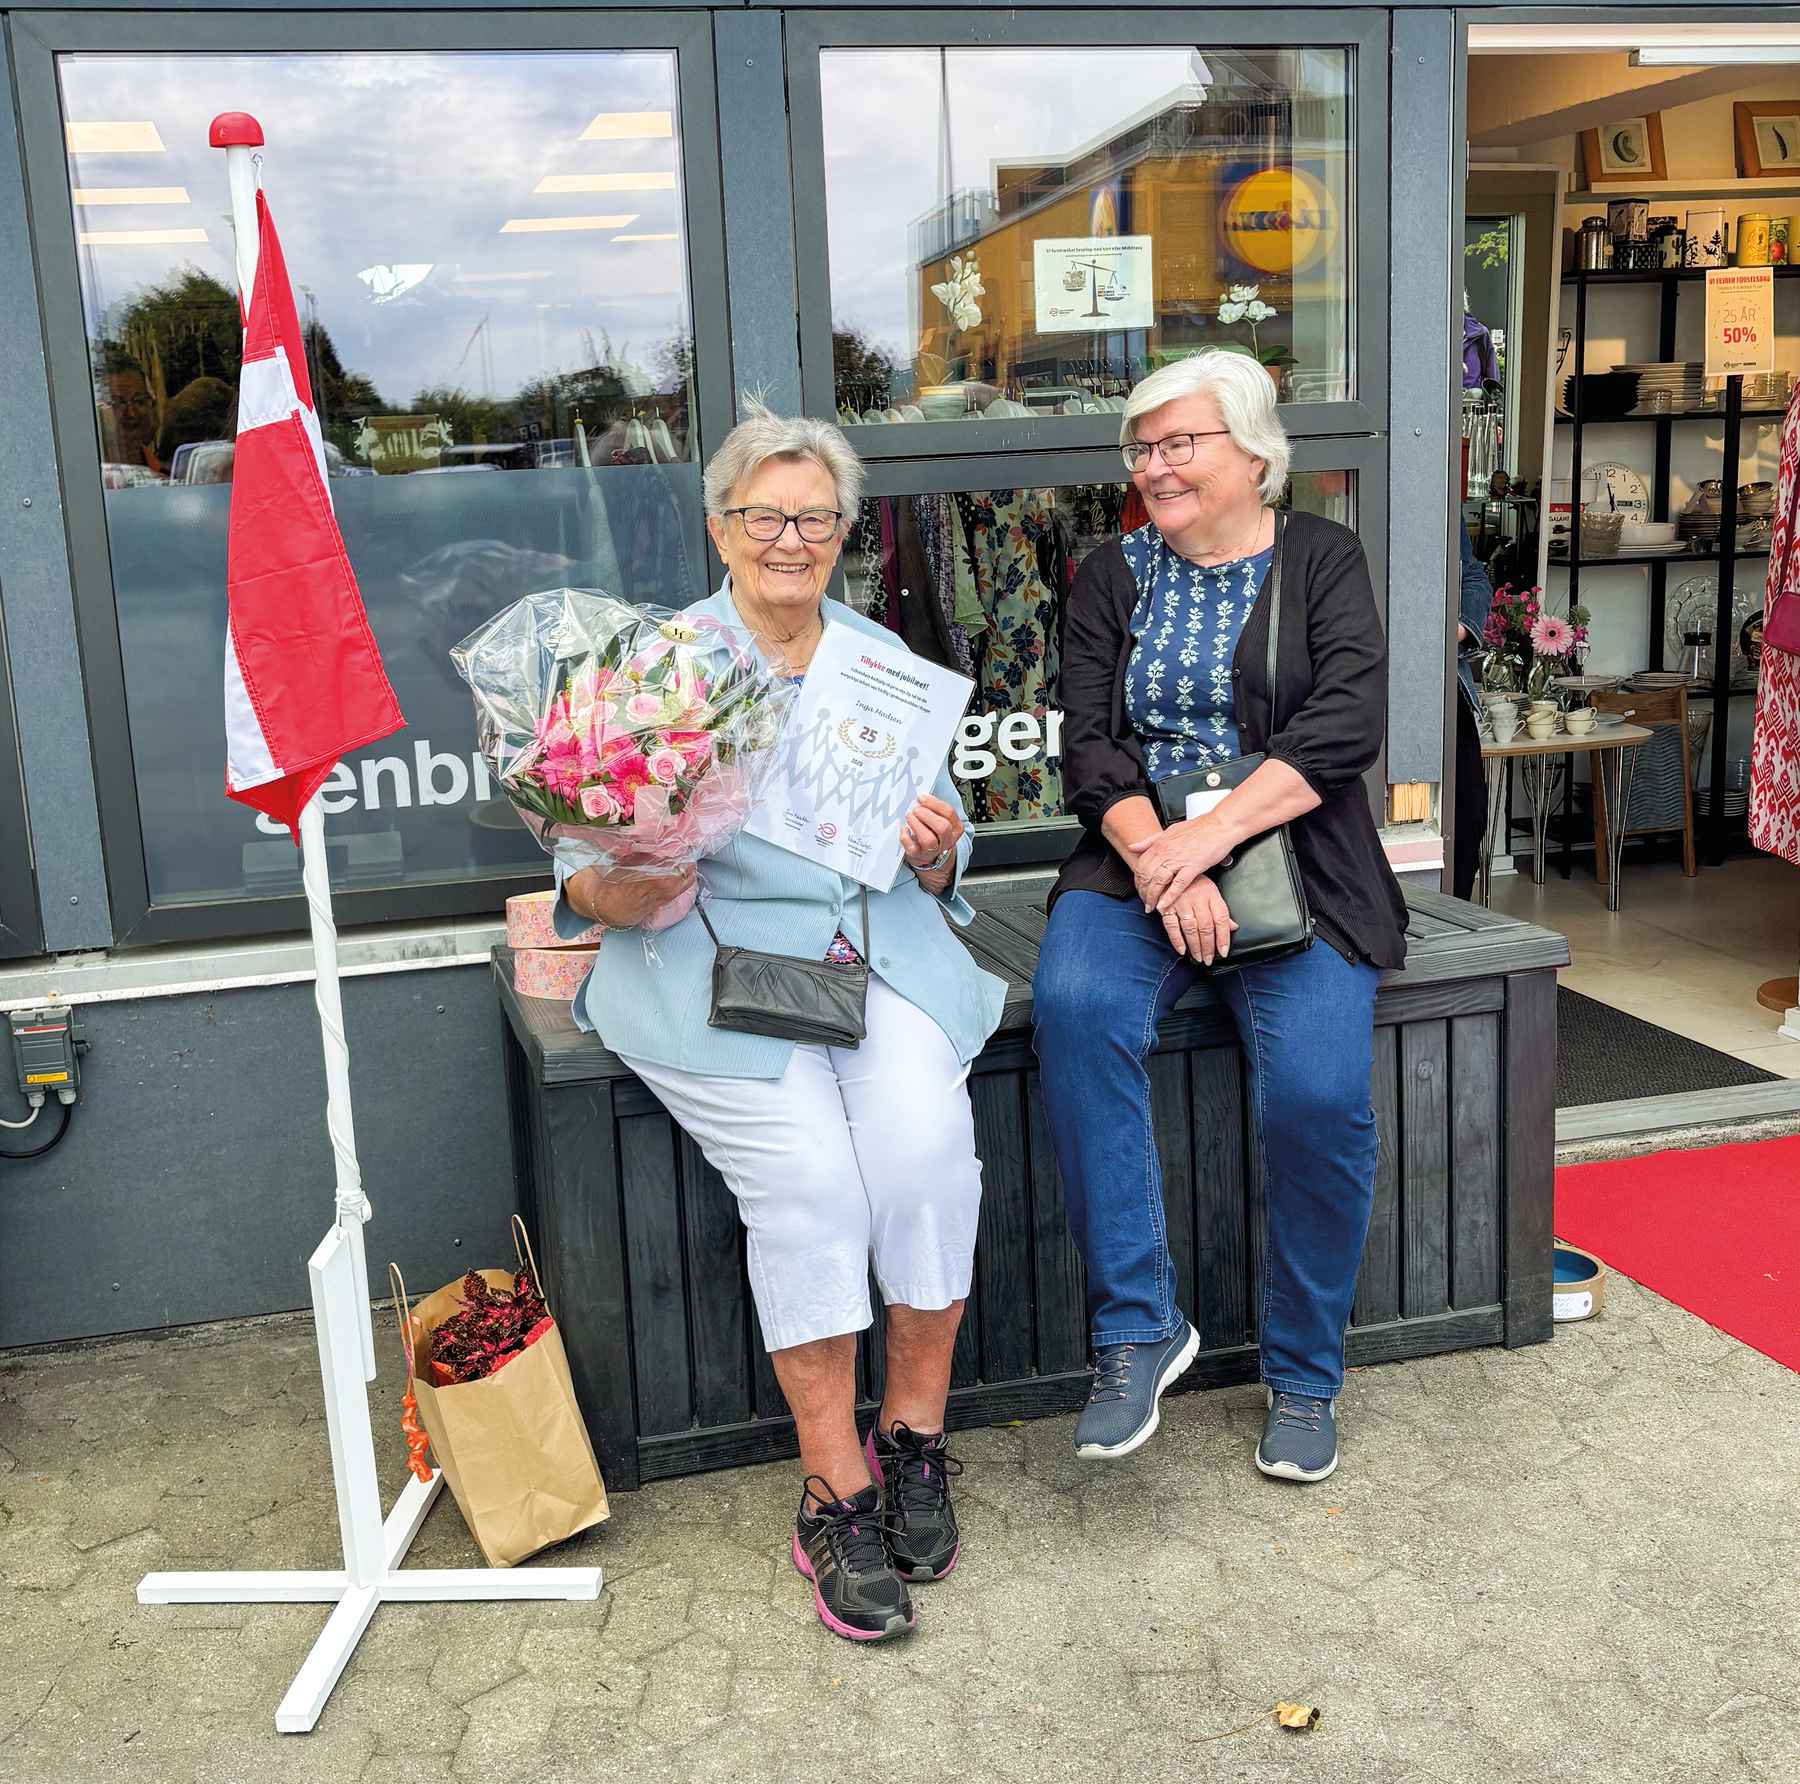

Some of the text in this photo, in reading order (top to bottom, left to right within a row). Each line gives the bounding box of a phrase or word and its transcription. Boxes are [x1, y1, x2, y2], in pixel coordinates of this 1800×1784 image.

[1723, 306, 1756, 324] 25 ÅR
[1723, 327, 1757, 344] 50%
[1606, 468, 1616, 478] 12
[1630, 485, 1638, 494] 2
[1634, 499, 1642, 509] 3
[1630, 513, 1638, 521] 4
[859, 726, 878, 743] 25
